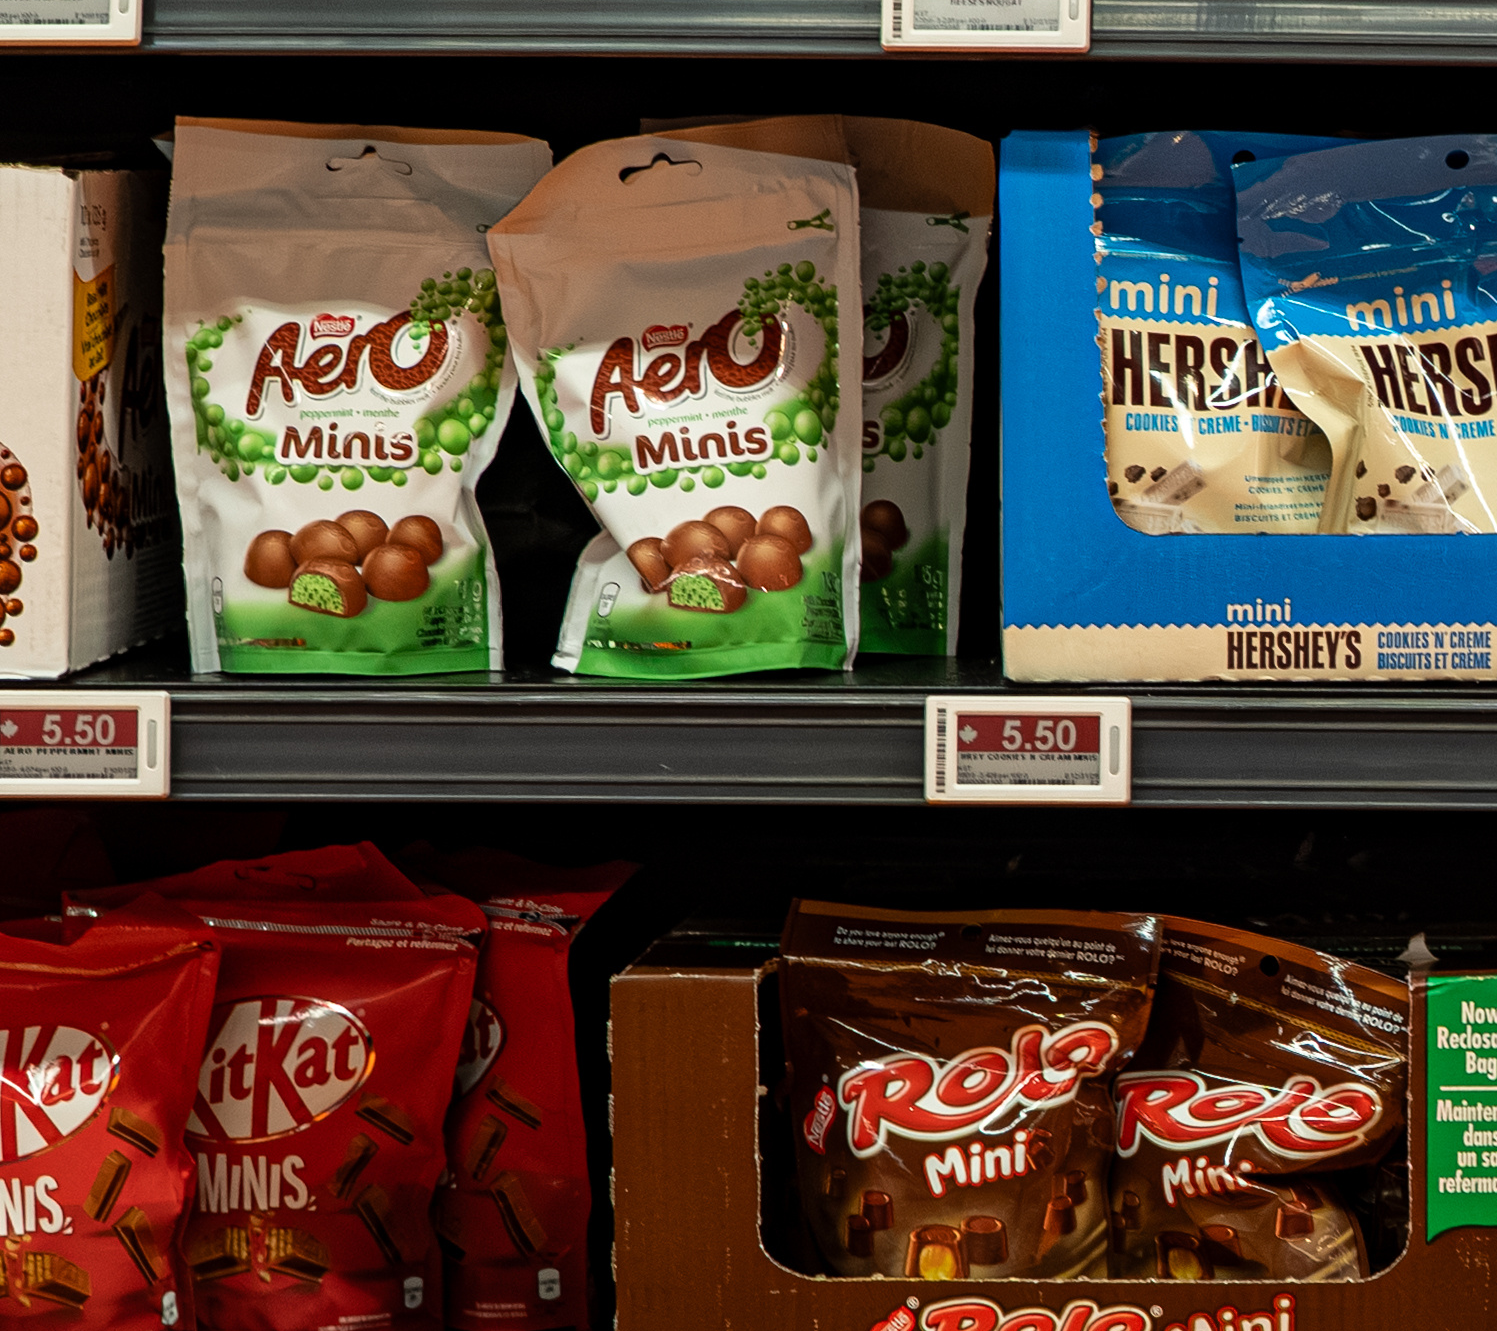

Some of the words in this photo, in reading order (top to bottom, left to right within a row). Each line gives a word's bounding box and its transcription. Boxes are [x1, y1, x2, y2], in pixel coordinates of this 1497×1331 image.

[283, 426, 413, 462] Minis
[1226, 599, 1292, 622] mini
[1227, 632, 1361, 670] HERSHEY'S
[1377, 632, 1428, 649] COOKIES
[1377, 653, 1433, 670] BISCUITS
[1436, 653, 1450, 670] ET
[1453, 649, 1491, 670] CRÈME
[42, 713, 116, 745] 5.50
[1001, 720, 1076, 750] 5.50
[1465, 1053, 1497, 1080] Bag
[1457, 1153, 1479, 1169] un
